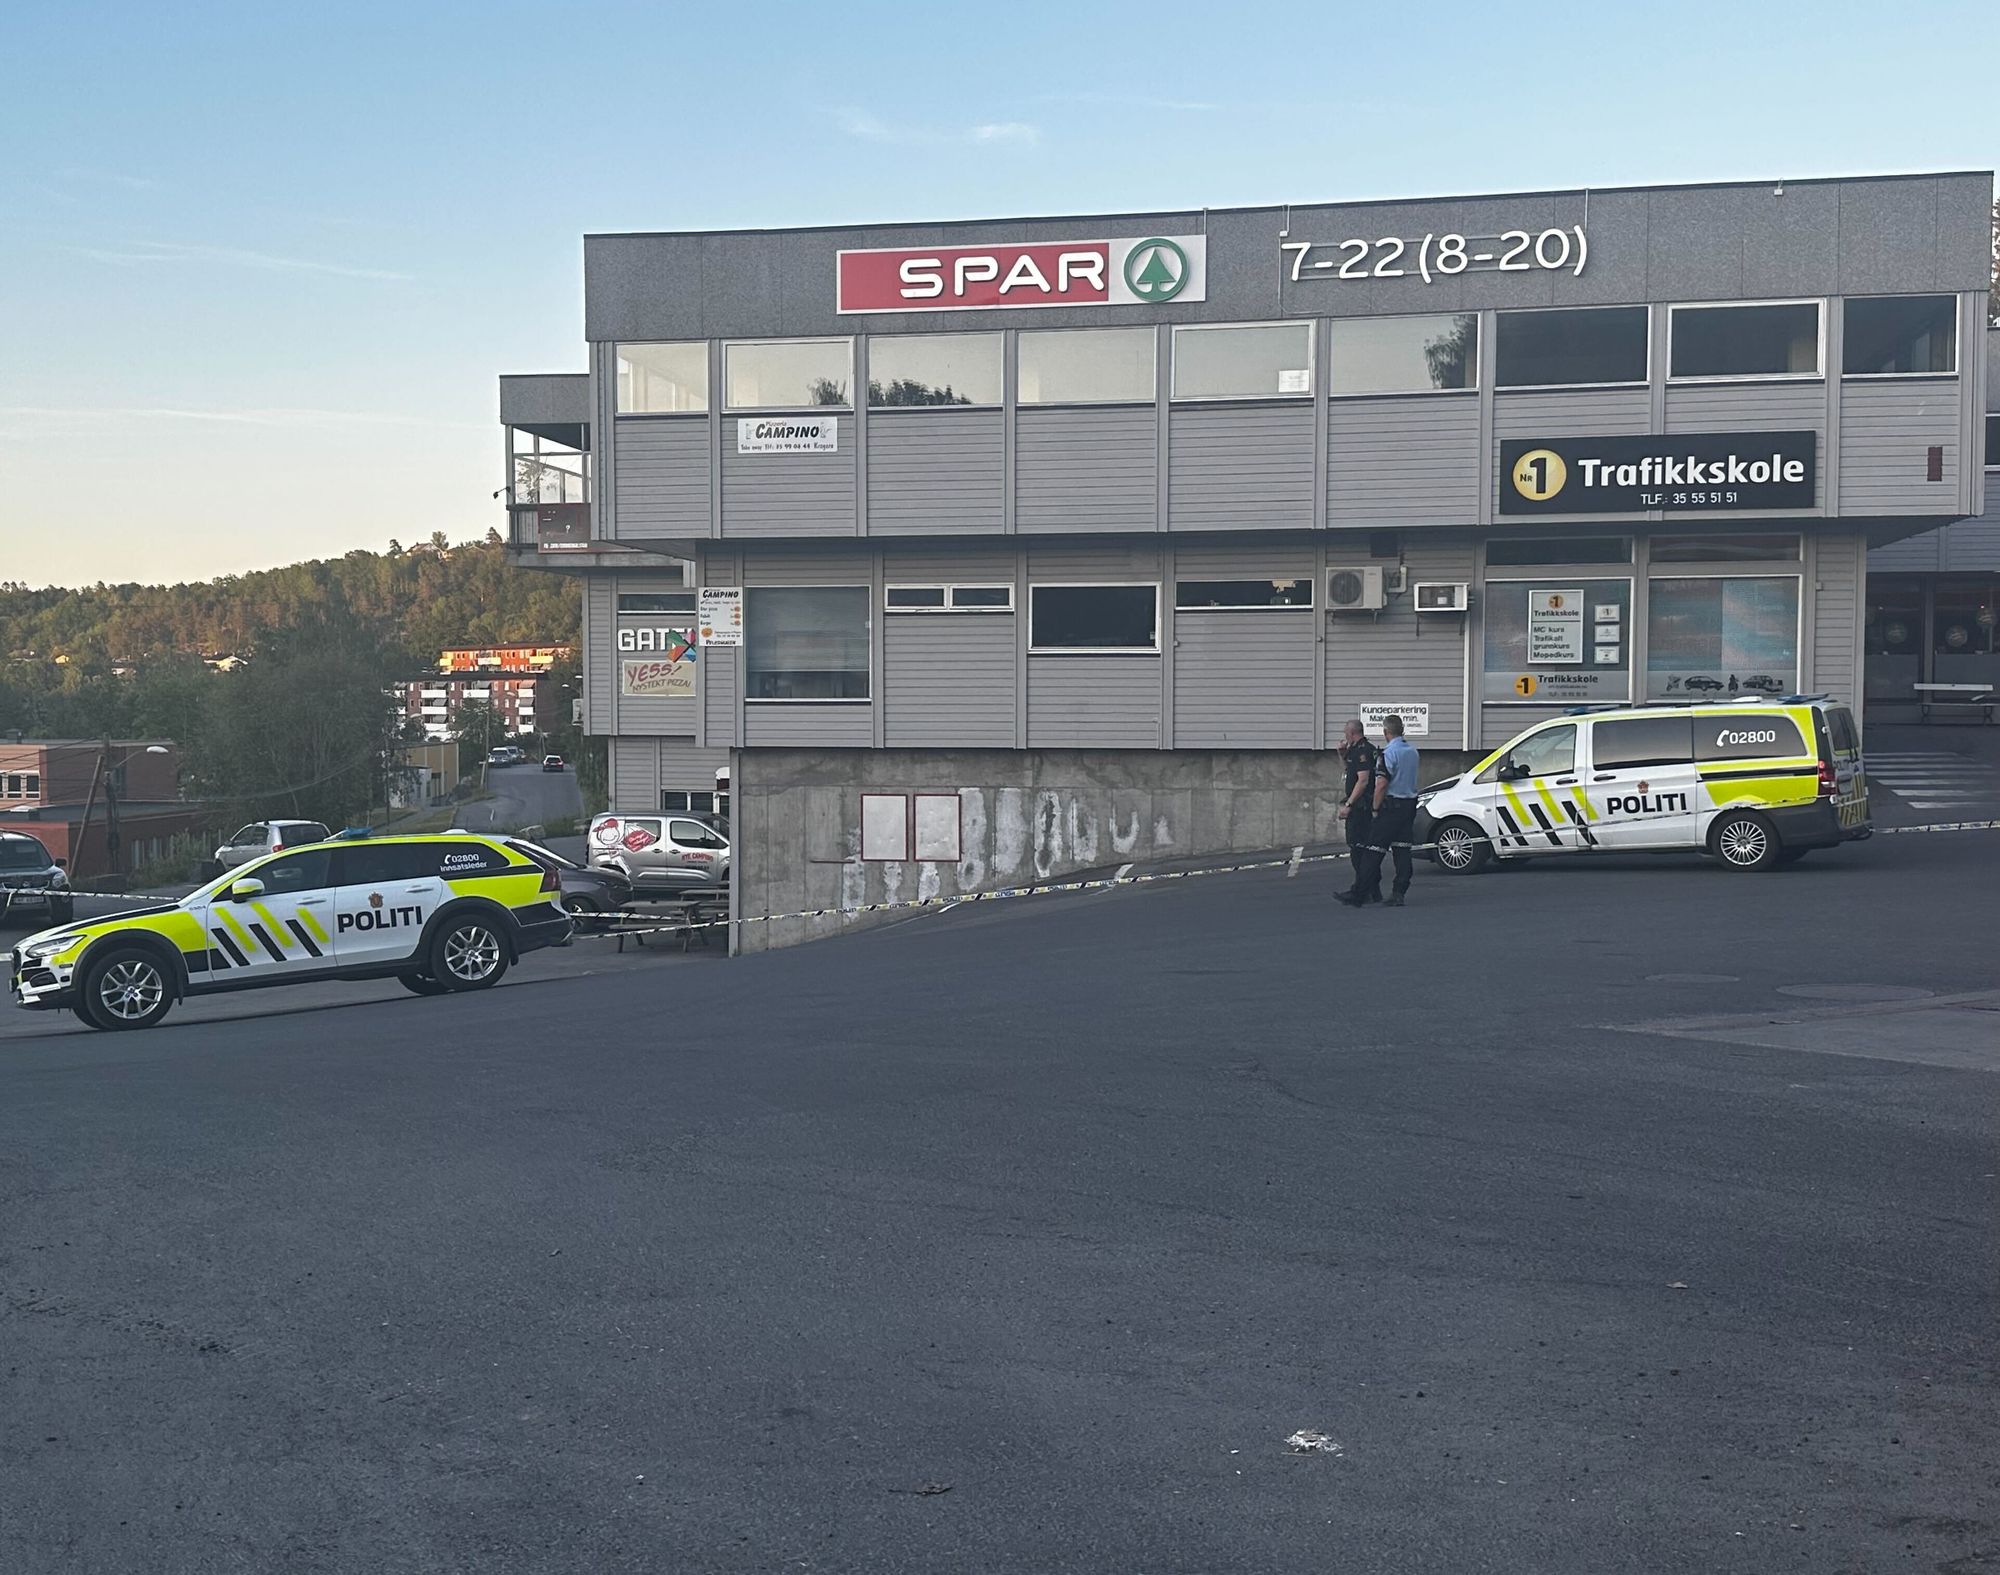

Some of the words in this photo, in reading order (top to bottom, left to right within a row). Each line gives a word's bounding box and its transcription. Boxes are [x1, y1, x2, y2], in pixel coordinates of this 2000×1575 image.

[1281, 237, 1404, 281] 7-22
[1419, 225, 1587, 284] (8-20)
[900, 251, 1105, 298] SPAR
[755, 423, 820, 439] CAMPINO
[1529, 457, 1547, 494] 1
[1578, 454, 1804, 487] Trafikkskole
[1672, 493, 1687, 504] 35
[1691, 493, 1706, 504] 55
[1710, 493, 1722, 503] 51
[1726, 492, 1737, 503] 51
[627, 663, 682, 687] YESS!
[1538, 675, 1598, 683] Trafikkskole
[1362, 706, 1427, 714] Kundeparkering
[1730, 730, 1776, 744] 02800
[1607, 793, 1687, 815] POLITI
[451, 854, 479, 863] 02800
[337, 906, 422, 933] POLITI
